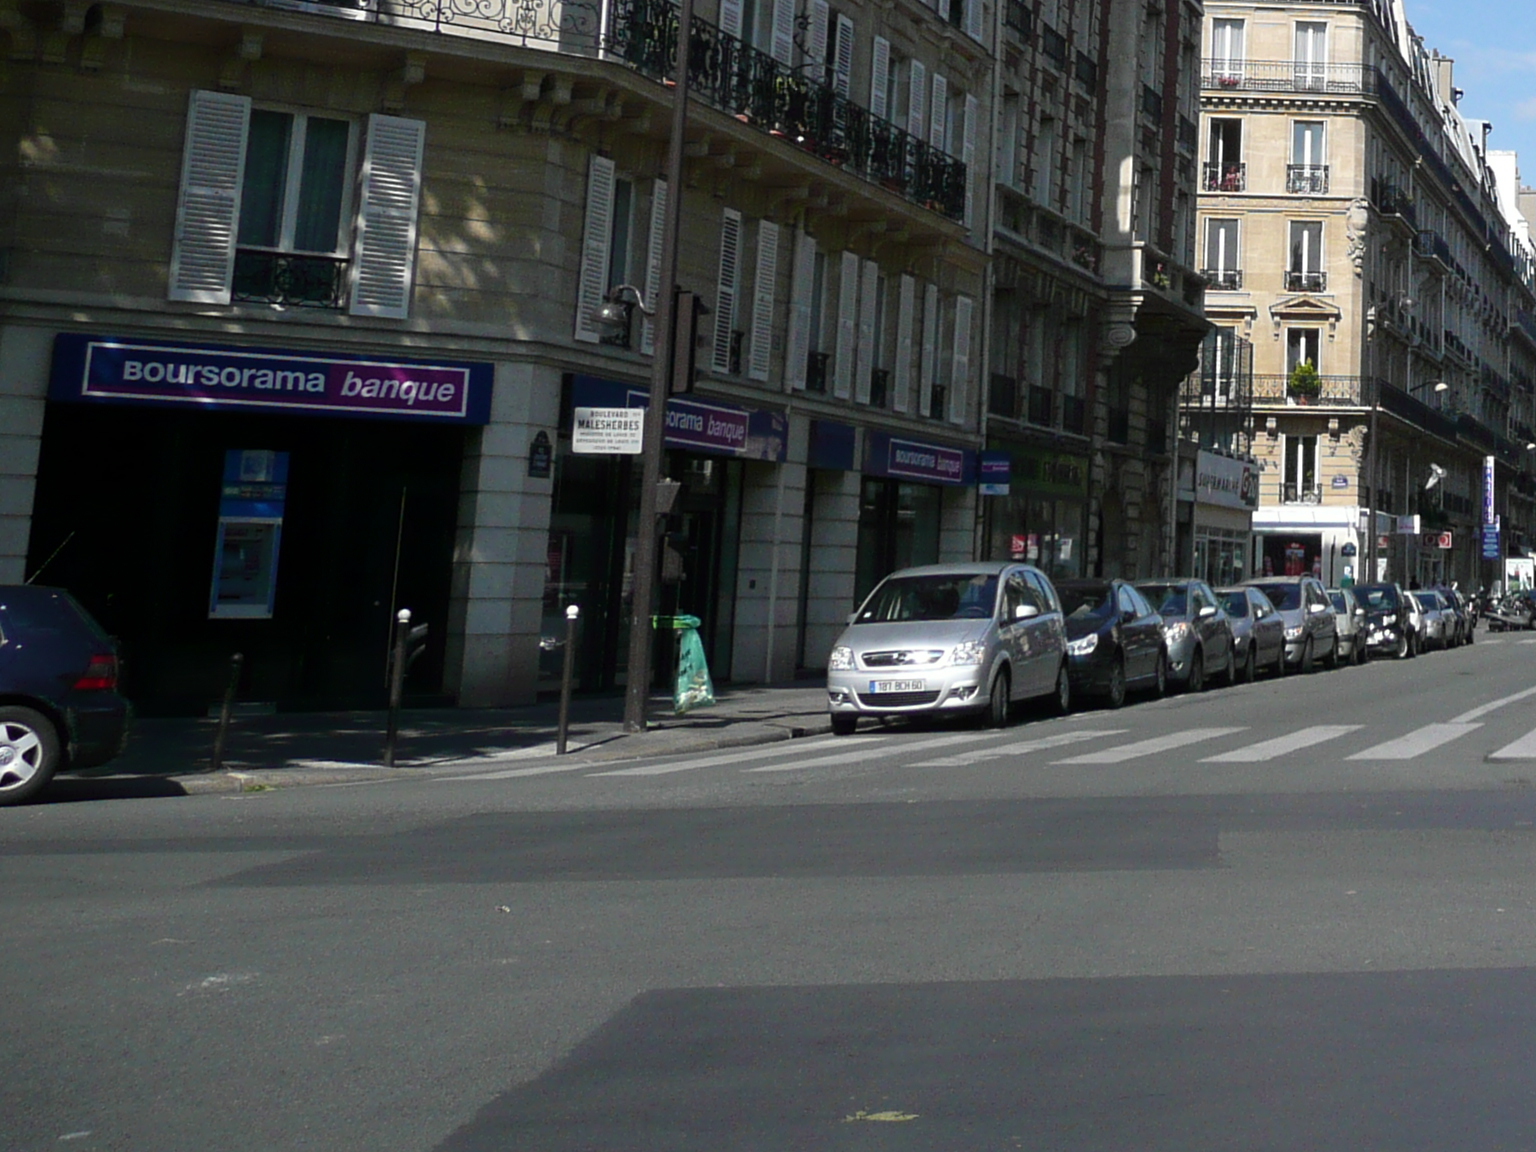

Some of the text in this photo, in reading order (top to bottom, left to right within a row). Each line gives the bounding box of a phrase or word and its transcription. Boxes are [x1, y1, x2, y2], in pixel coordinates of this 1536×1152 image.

[123, 360, 455, 405] Boursorama banque
[590, 410, 629, 418] BOULEVARD
[577, 419, 640, 431] MALESHERBES
[706, 415, 745, 443] banque
